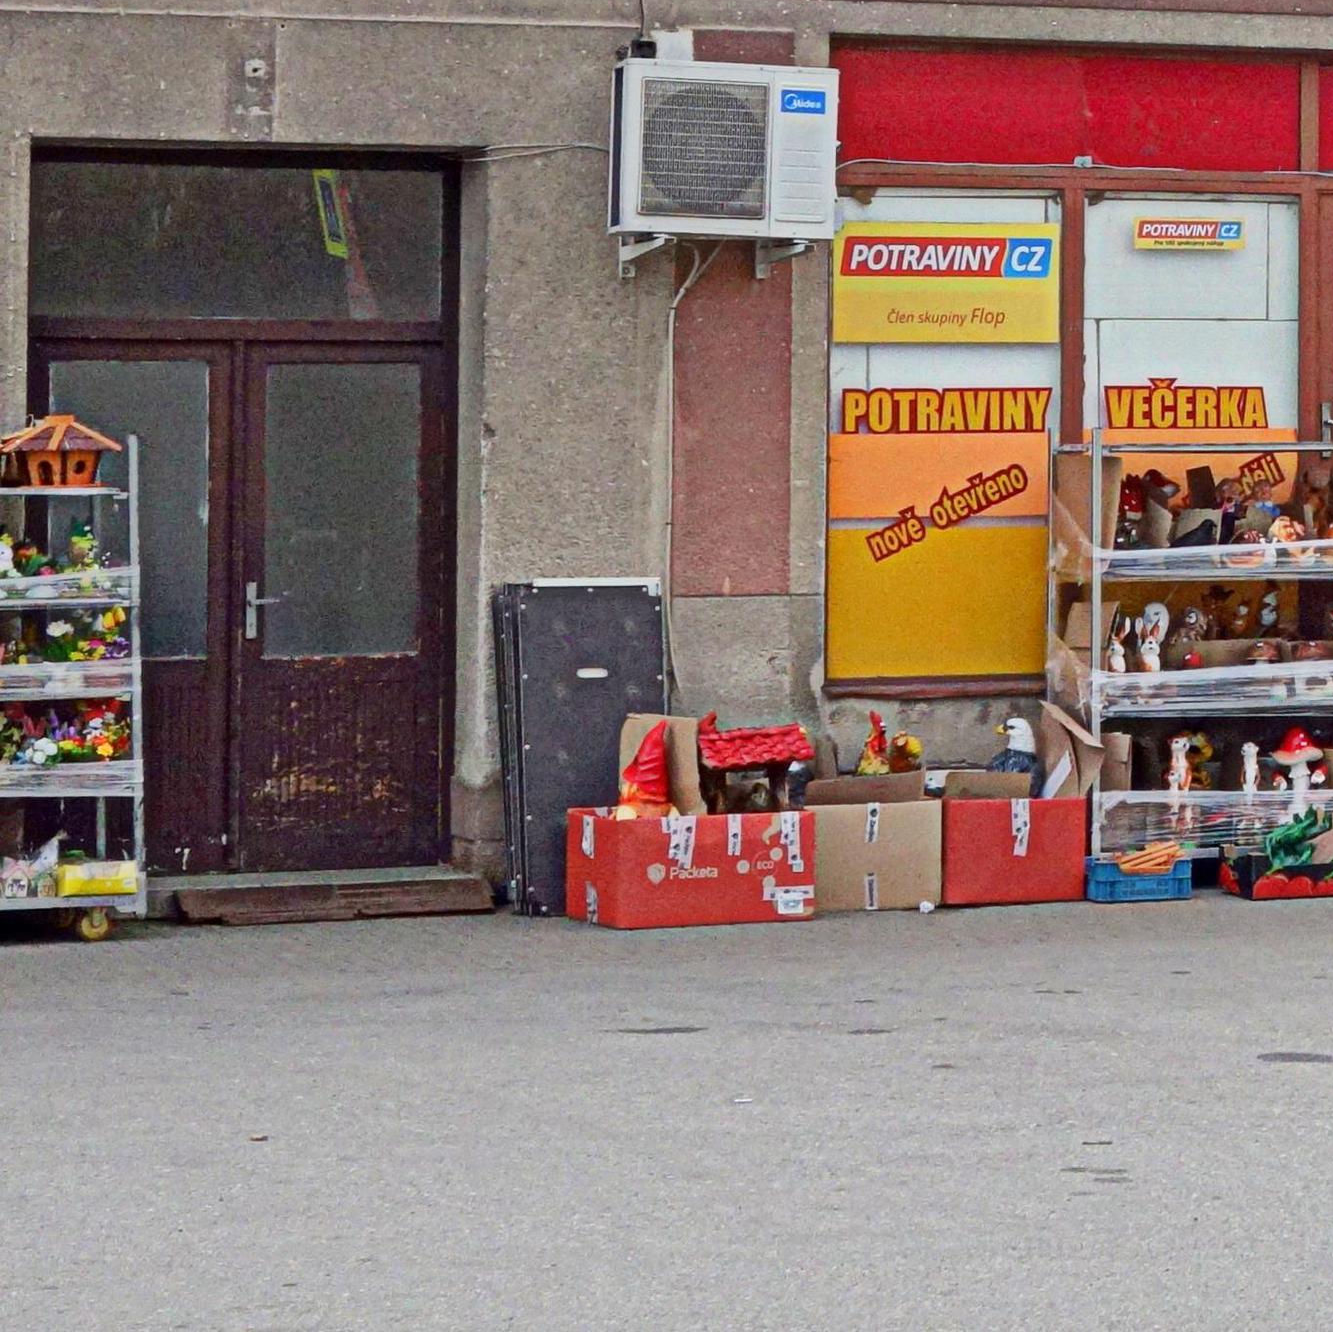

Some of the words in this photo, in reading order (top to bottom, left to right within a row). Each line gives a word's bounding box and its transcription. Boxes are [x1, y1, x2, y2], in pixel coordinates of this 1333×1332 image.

[1142, 224, 1215, 236] POTRAVINY
[1221, 224, 1238, 236] CZ
[850, 244, 999, 271] POTRAVINY
[1011, 246, 1045, 272] CZ
[887, 308, 914, 324] Člen
[918, 310, 967, 327] skupiny
[970, 307, 1006, 328] Flop
[843, 388, 1051, 433] POTRAVINY
[1104, 378, 1268, 428] VEČERKA
[866, 506, 926, 562] nově
[930, 464, 1028, 530] otevřeno
[669, 865, 718, 880] Packeta
